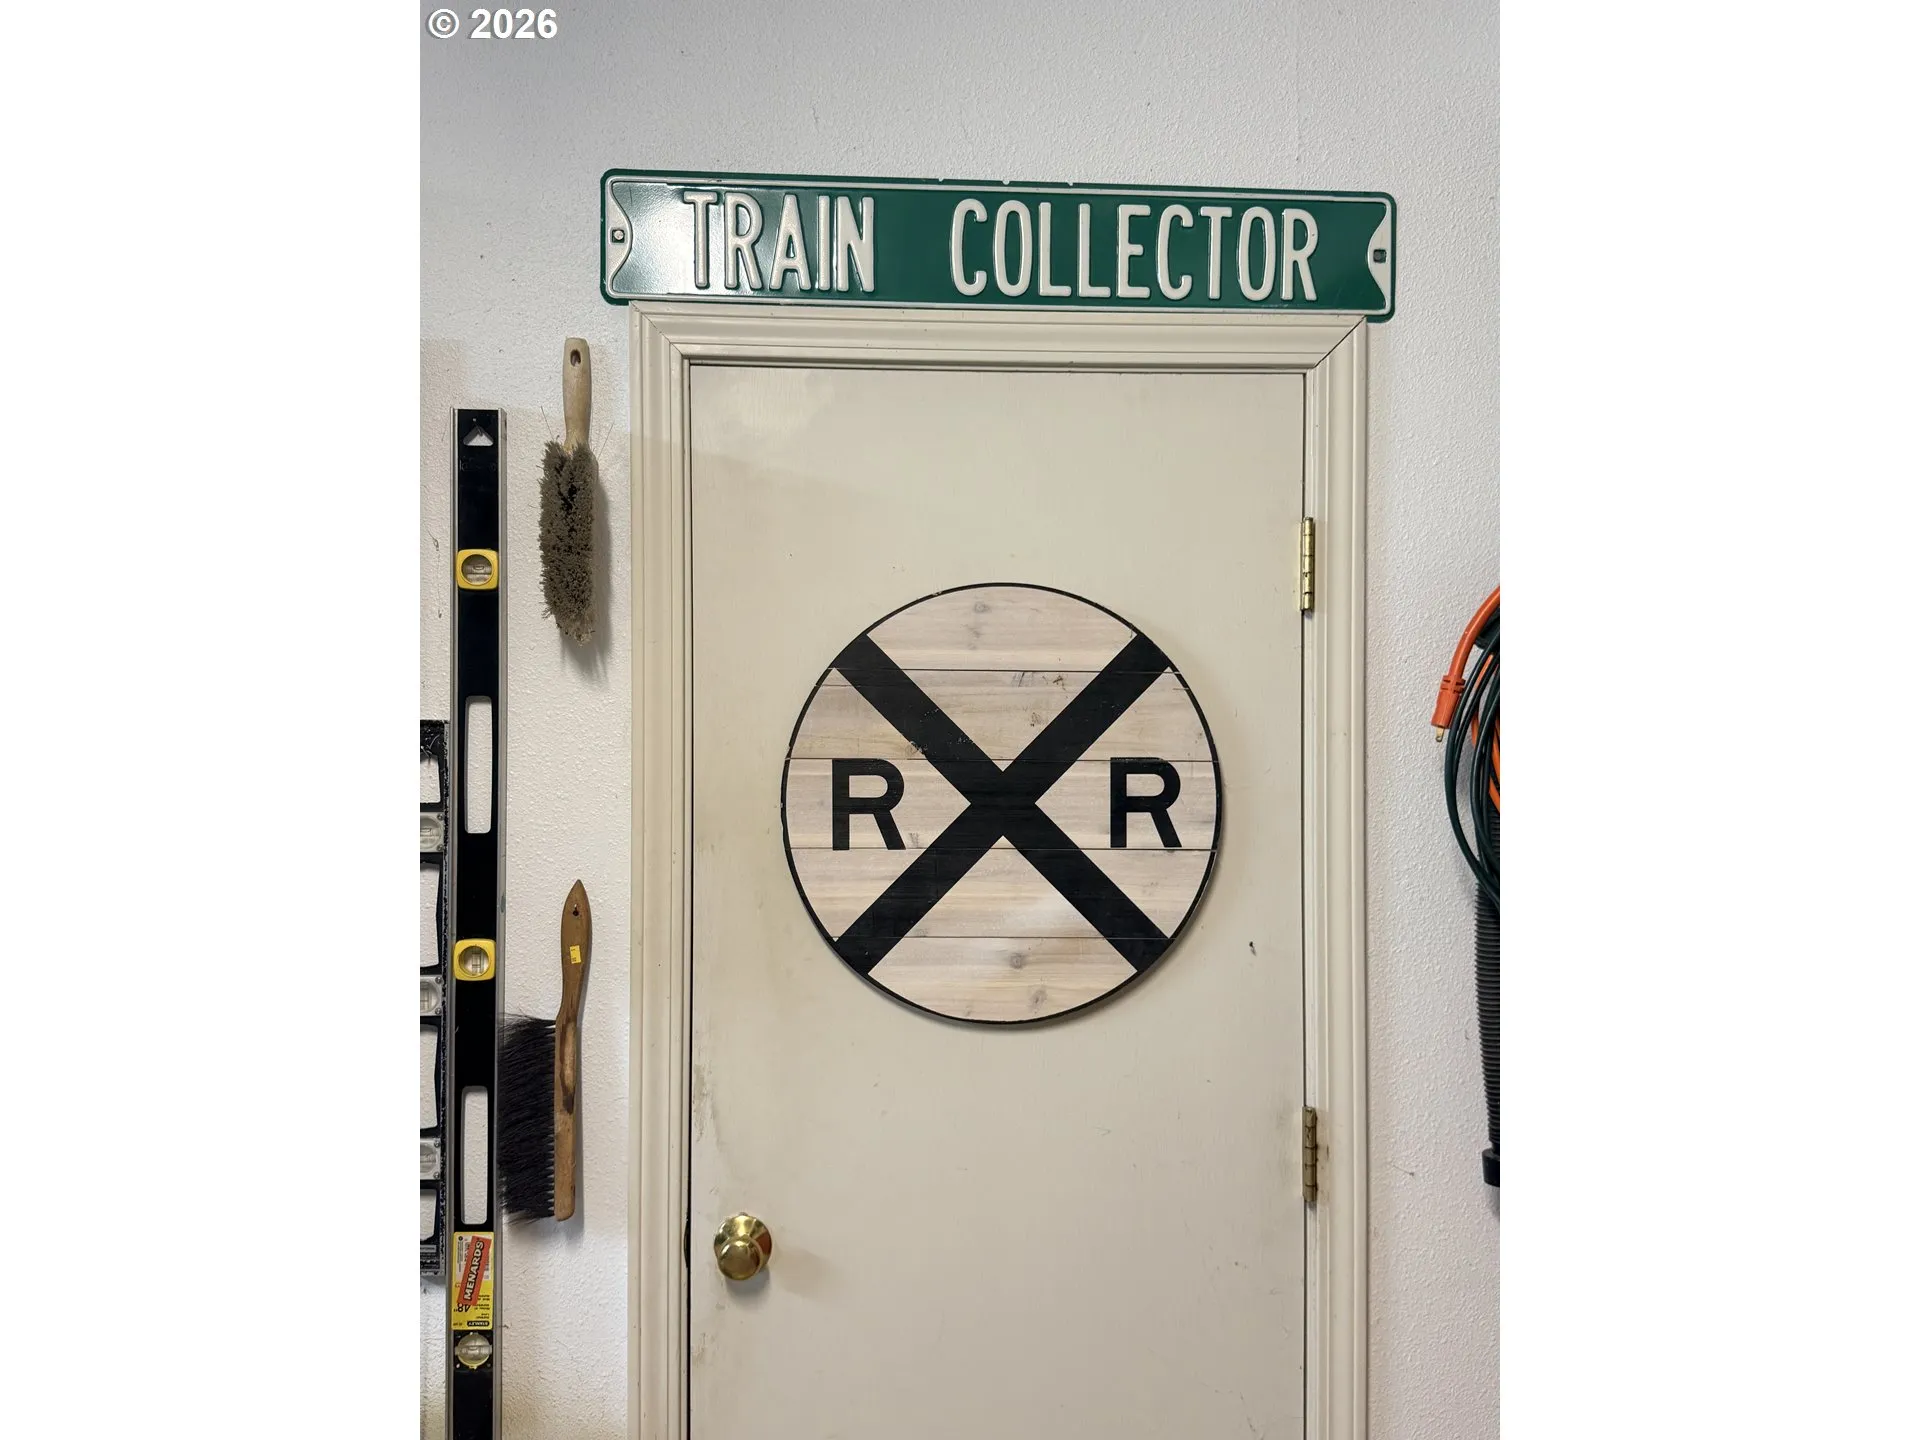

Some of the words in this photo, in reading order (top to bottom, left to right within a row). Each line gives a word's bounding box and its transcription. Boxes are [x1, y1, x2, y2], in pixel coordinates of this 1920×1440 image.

[683, 190, 875, 293] TRAIN
[951, 198, 1319, 301] COLLECTOR
[832, 758, 906, 851] R
[1110, 757, 1182, 849] R
[463, 1240, 485, 1301] MENARDS
